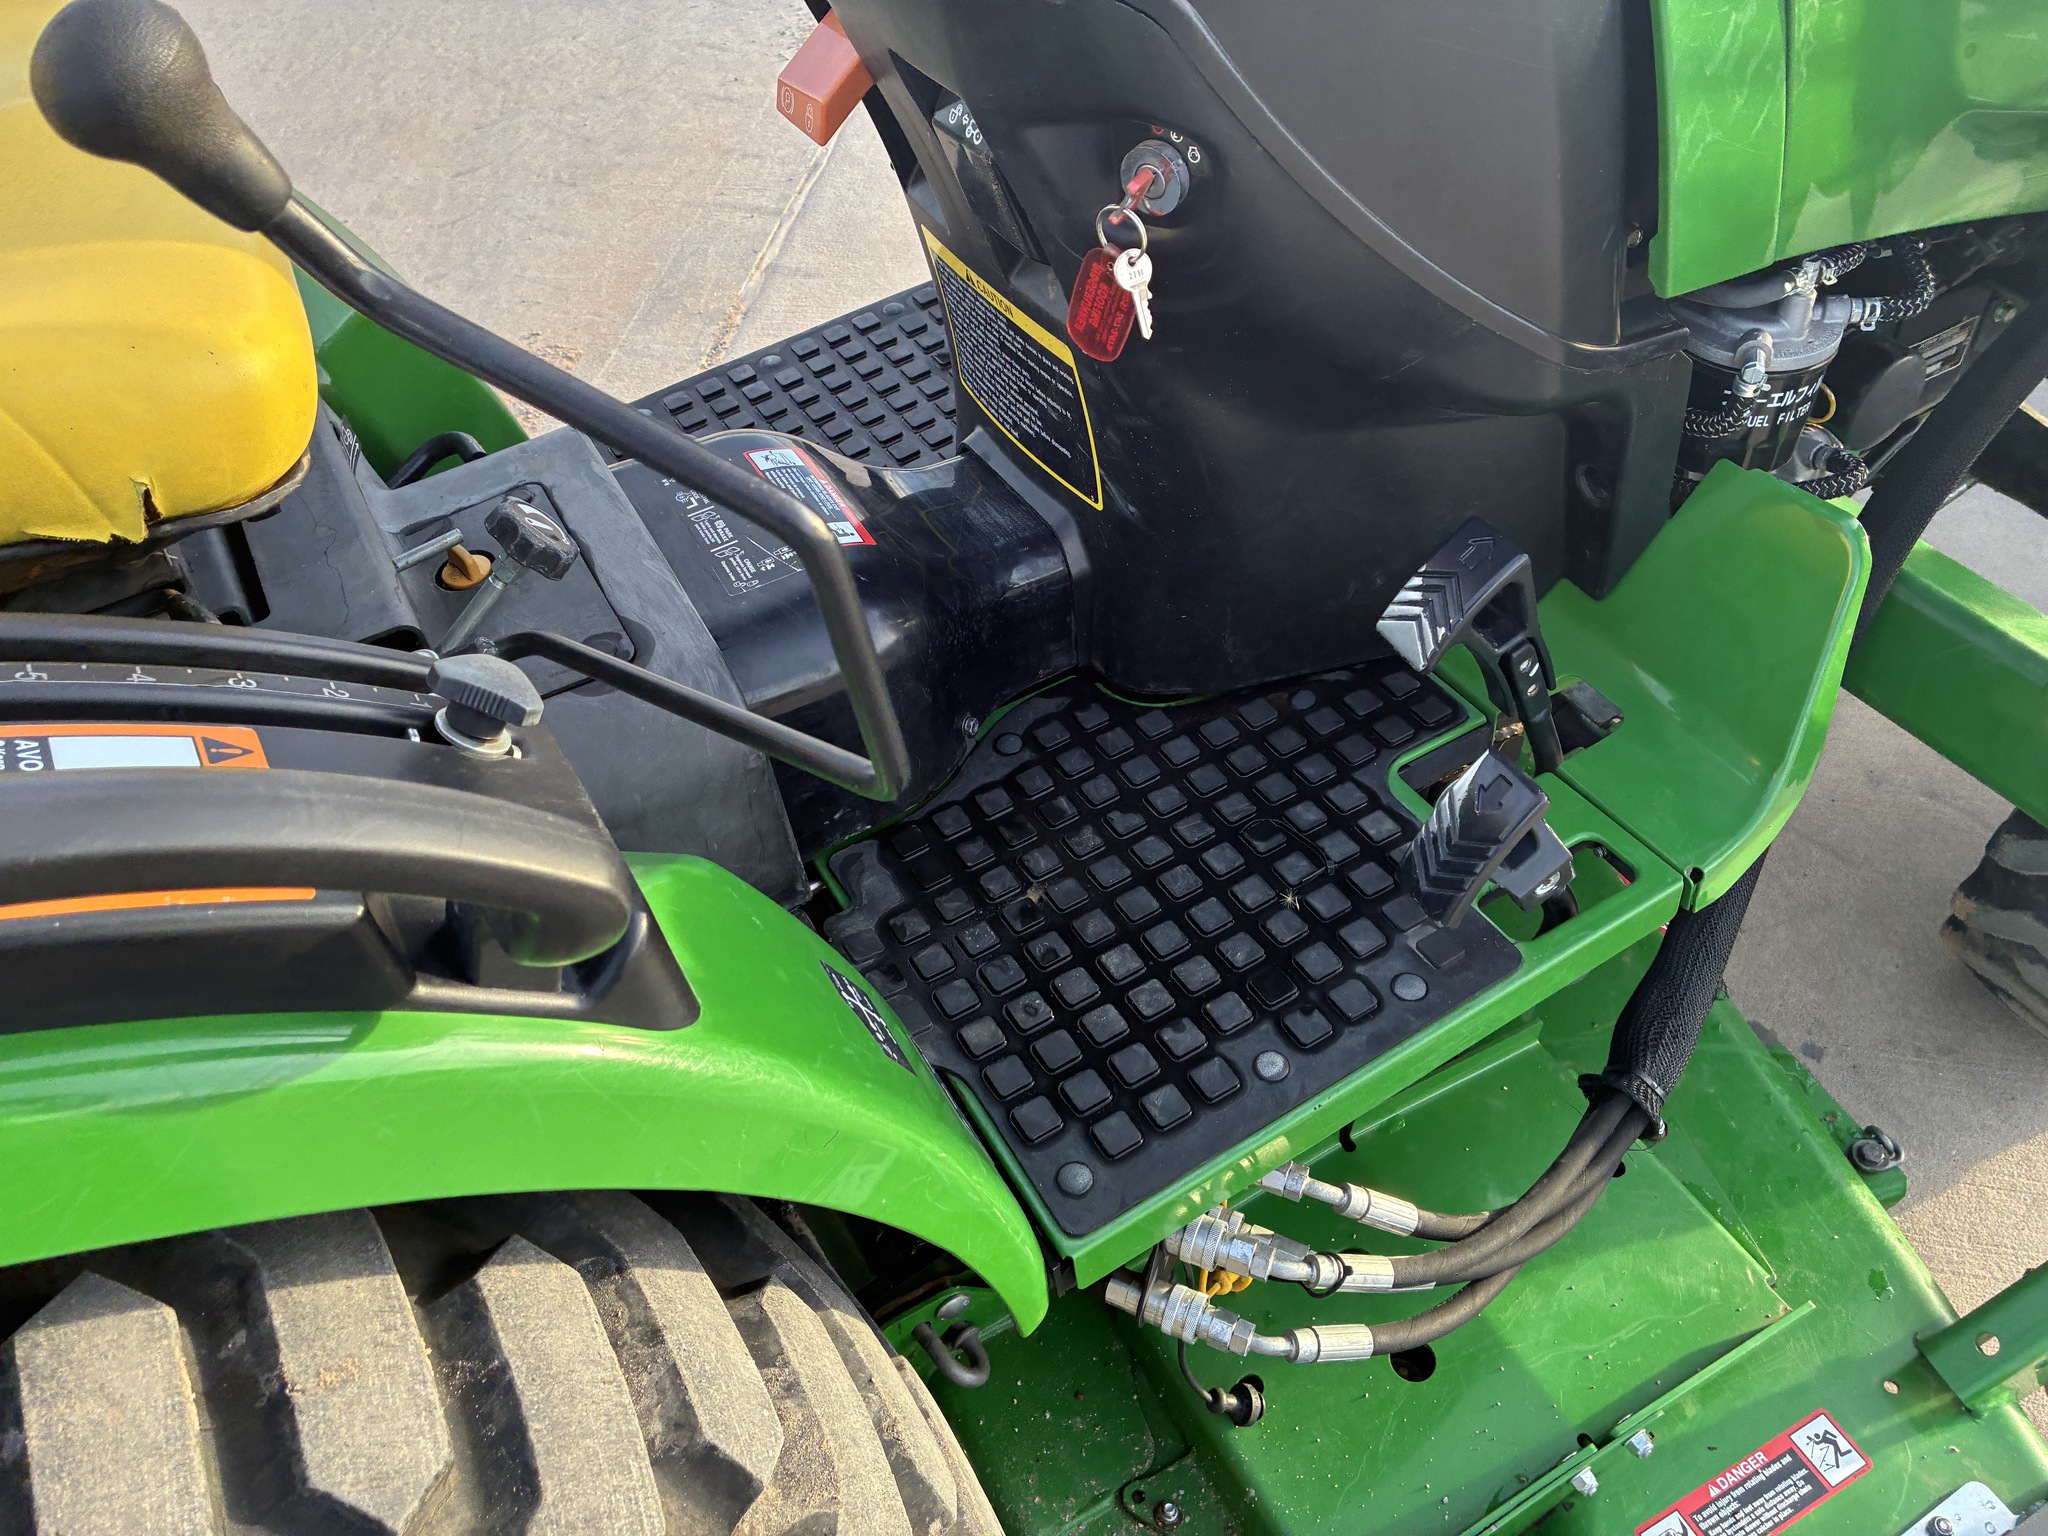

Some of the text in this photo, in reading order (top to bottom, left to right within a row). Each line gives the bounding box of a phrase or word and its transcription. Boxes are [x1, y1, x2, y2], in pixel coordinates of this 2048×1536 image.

[976, 280, 1014, 319] CAUTION
[1745, 401, 1812, 428] UEL FILTER
[822, 484, 846, 507] DANGER
[716, 528, 729, 541] BRAKE
[722, 527, 733, 538] PARK
[14, 671, 48, 681] 5
[126, 673, 157, 682] 4
[228, 677, 257, 688] 3
[322, 687, 350, 698] 2
[14, 740, 44, 771] AVO
[1715, 1450, 1768, 1490] DANGER
[1692, 1453, 1792, 1523] To avoid injury from rotating blades and
[1707, 1524, 1723, 1536] Keep
[1733, 1509, 1745, 1520] and
[1741, 1503, 1754, 1514] feet
[1751, 1496, 1766, 1509] away
[1762, 1488, 1776, 1500] from
[1773, 1477, 1794, 1494] rotating
[1790, 1466, 1810, 1482] blades.
[1698, 1512, 1721, 1531] thrown
[1717, 1499, 1742, 1519] objects:
[1724, 1514, 1753, 1536] bystanders
[1753, 1505, 1766, 1516] safe
[1763, 1492, 1785, 1510] distance
[1795, 1477, 1805, 1487] Do
[1758, 1506, 1779, 1522] without
[1775, 1491, 1800, 1511] discharge
[1777, 1505, 1795, 1520] place.
